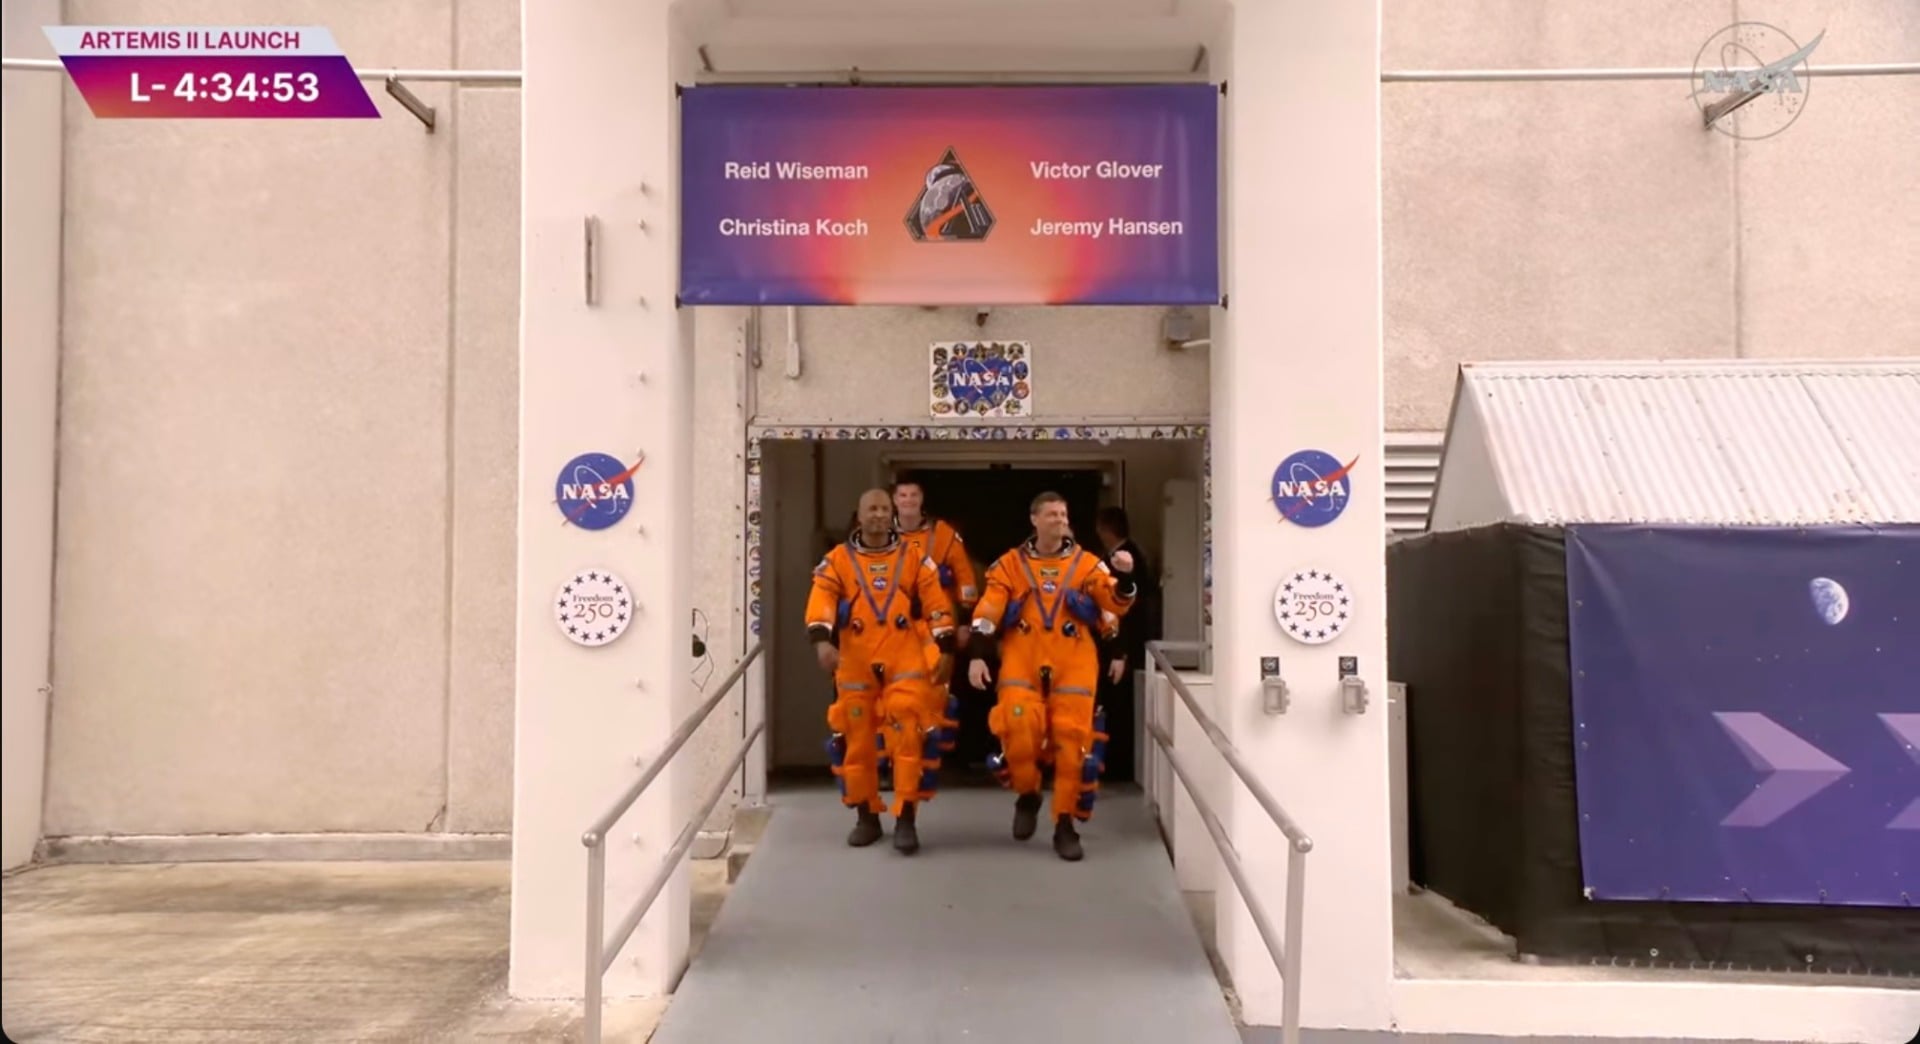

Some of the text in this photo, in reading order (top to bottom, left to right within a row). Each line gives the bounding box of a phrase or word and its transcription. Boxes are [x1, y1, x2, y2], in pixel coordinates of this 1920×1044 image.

[724, 161, 869, 180] Reid Wiseman
[1030, 161, 1163, 180] Victor Glover
[718, 218, 869, 237] Christina Koch
[1030, 217, 1184, 240] Jeremy Hansen
[952, 371, 1010, 387] NASA
[563, 484, 630, 500] NASA
[1278, 481, 1347, 497] NASA
[573, 594, 614, 602] Freedom
[1293, 592, 1335, 600] Freedom
[574, 603, 614, 624] 250
[1294, 600, 1335, 622] 250
